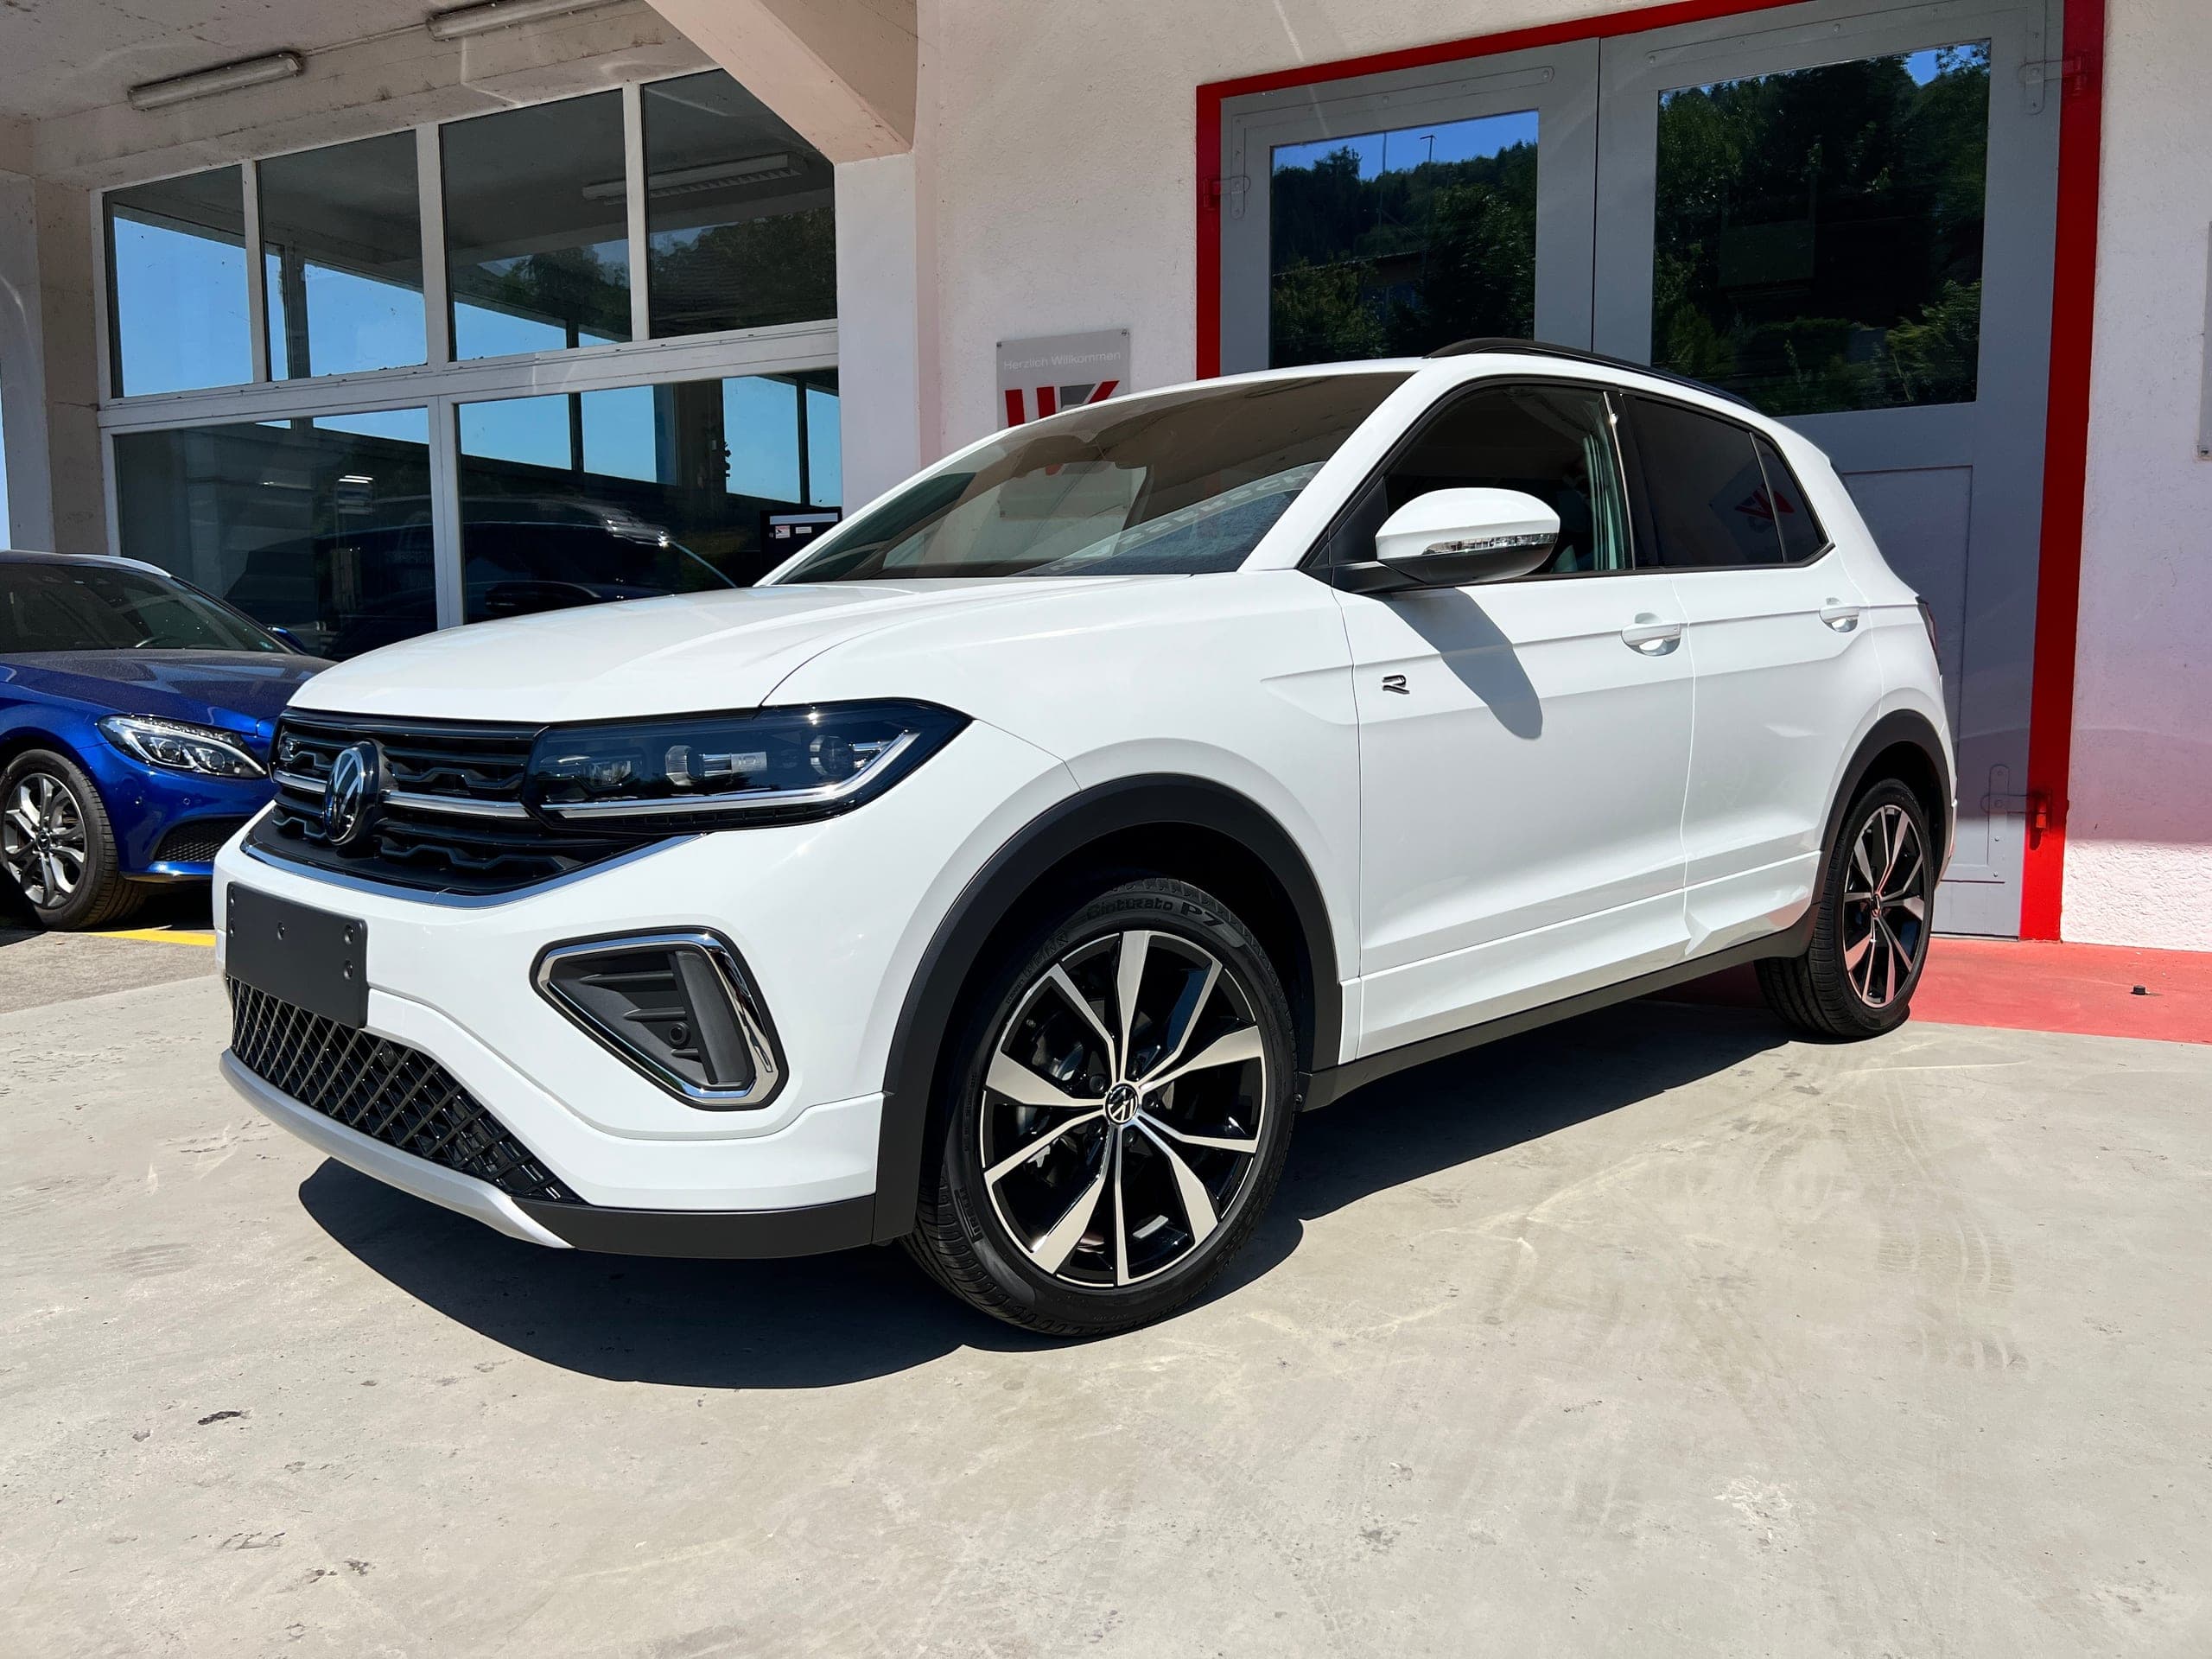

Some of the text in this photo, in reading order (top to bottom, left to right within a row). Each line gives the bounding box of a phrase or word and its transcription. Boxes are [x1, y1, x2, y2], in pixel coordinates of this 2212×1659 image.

[1003, 352, 1121, 370] Herzlich Willkommen
[1180, 901, 1224, 927] P7
